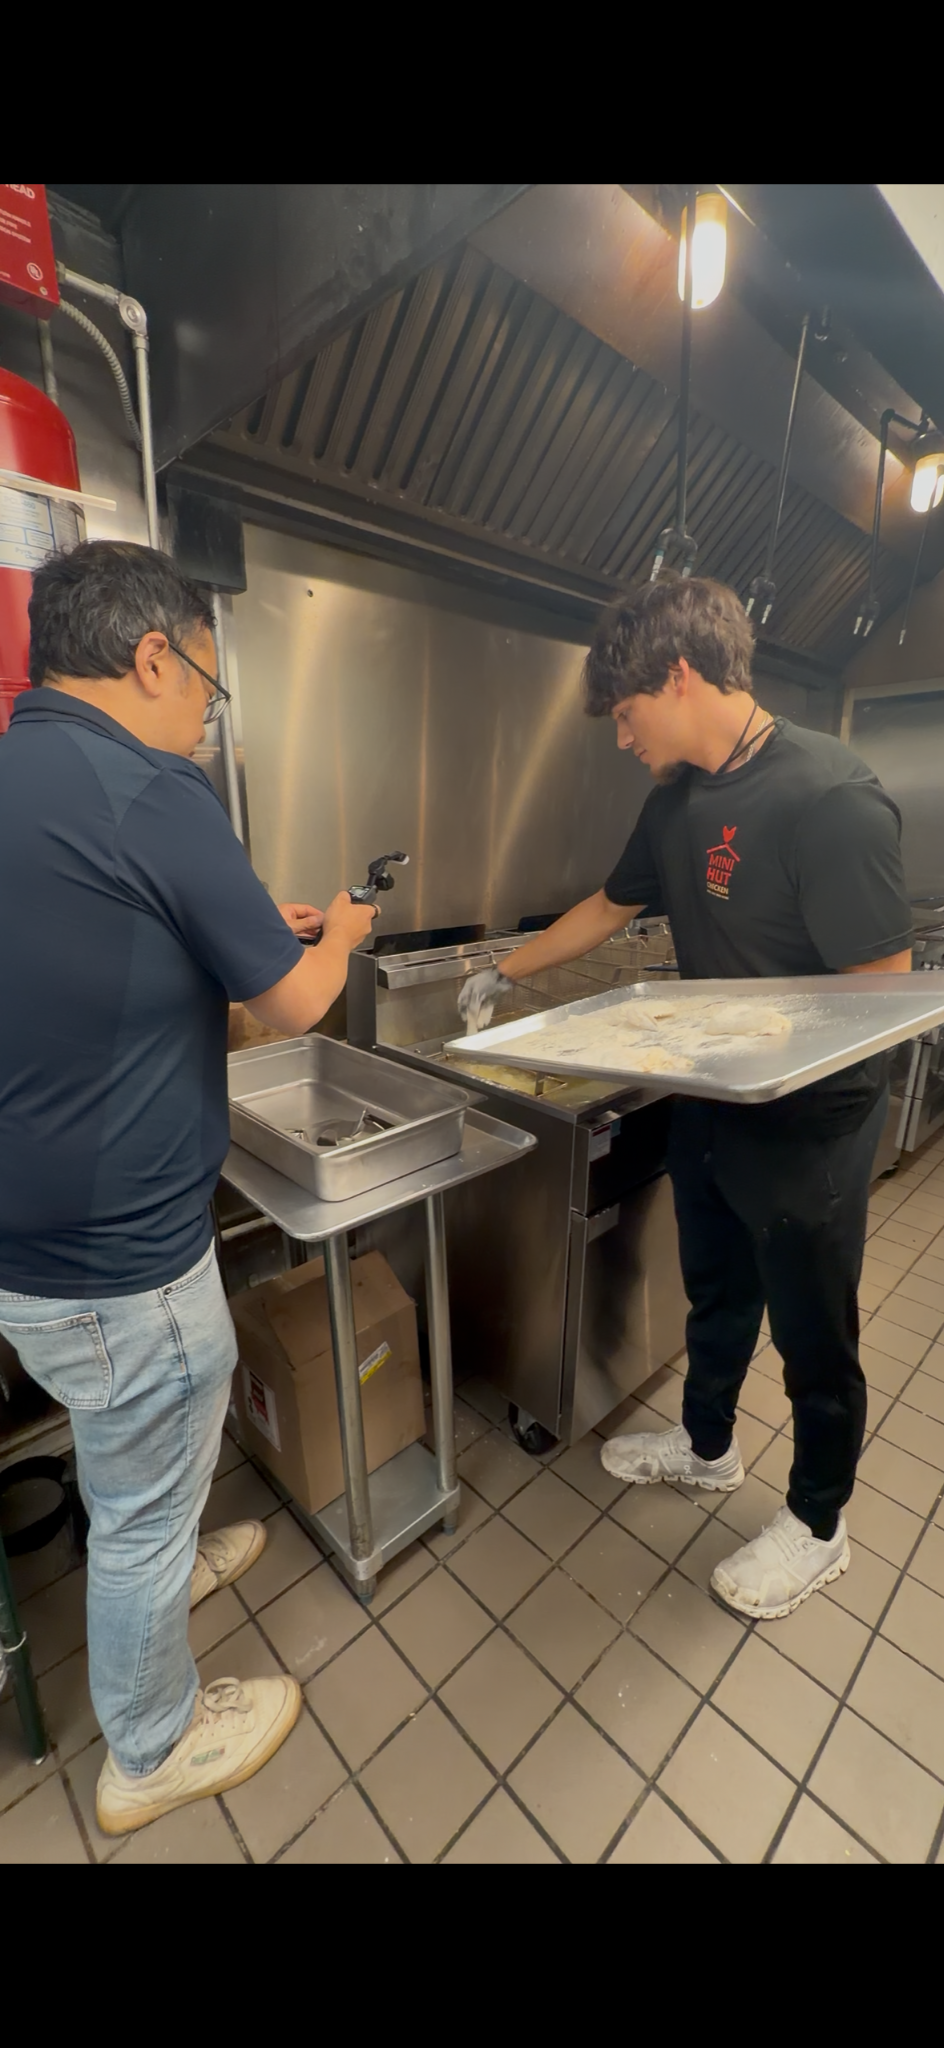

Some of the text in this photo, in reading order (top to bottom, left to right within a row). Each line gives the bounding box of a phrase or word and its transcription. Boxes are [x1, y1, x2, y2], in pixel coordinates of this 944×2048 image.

[5, 184, 35, 199] EAD
[709, 854, 735, 871] MINI
[706, 867, 731, 885] HUT
[707, 881, 729, 895] CHICKEN
